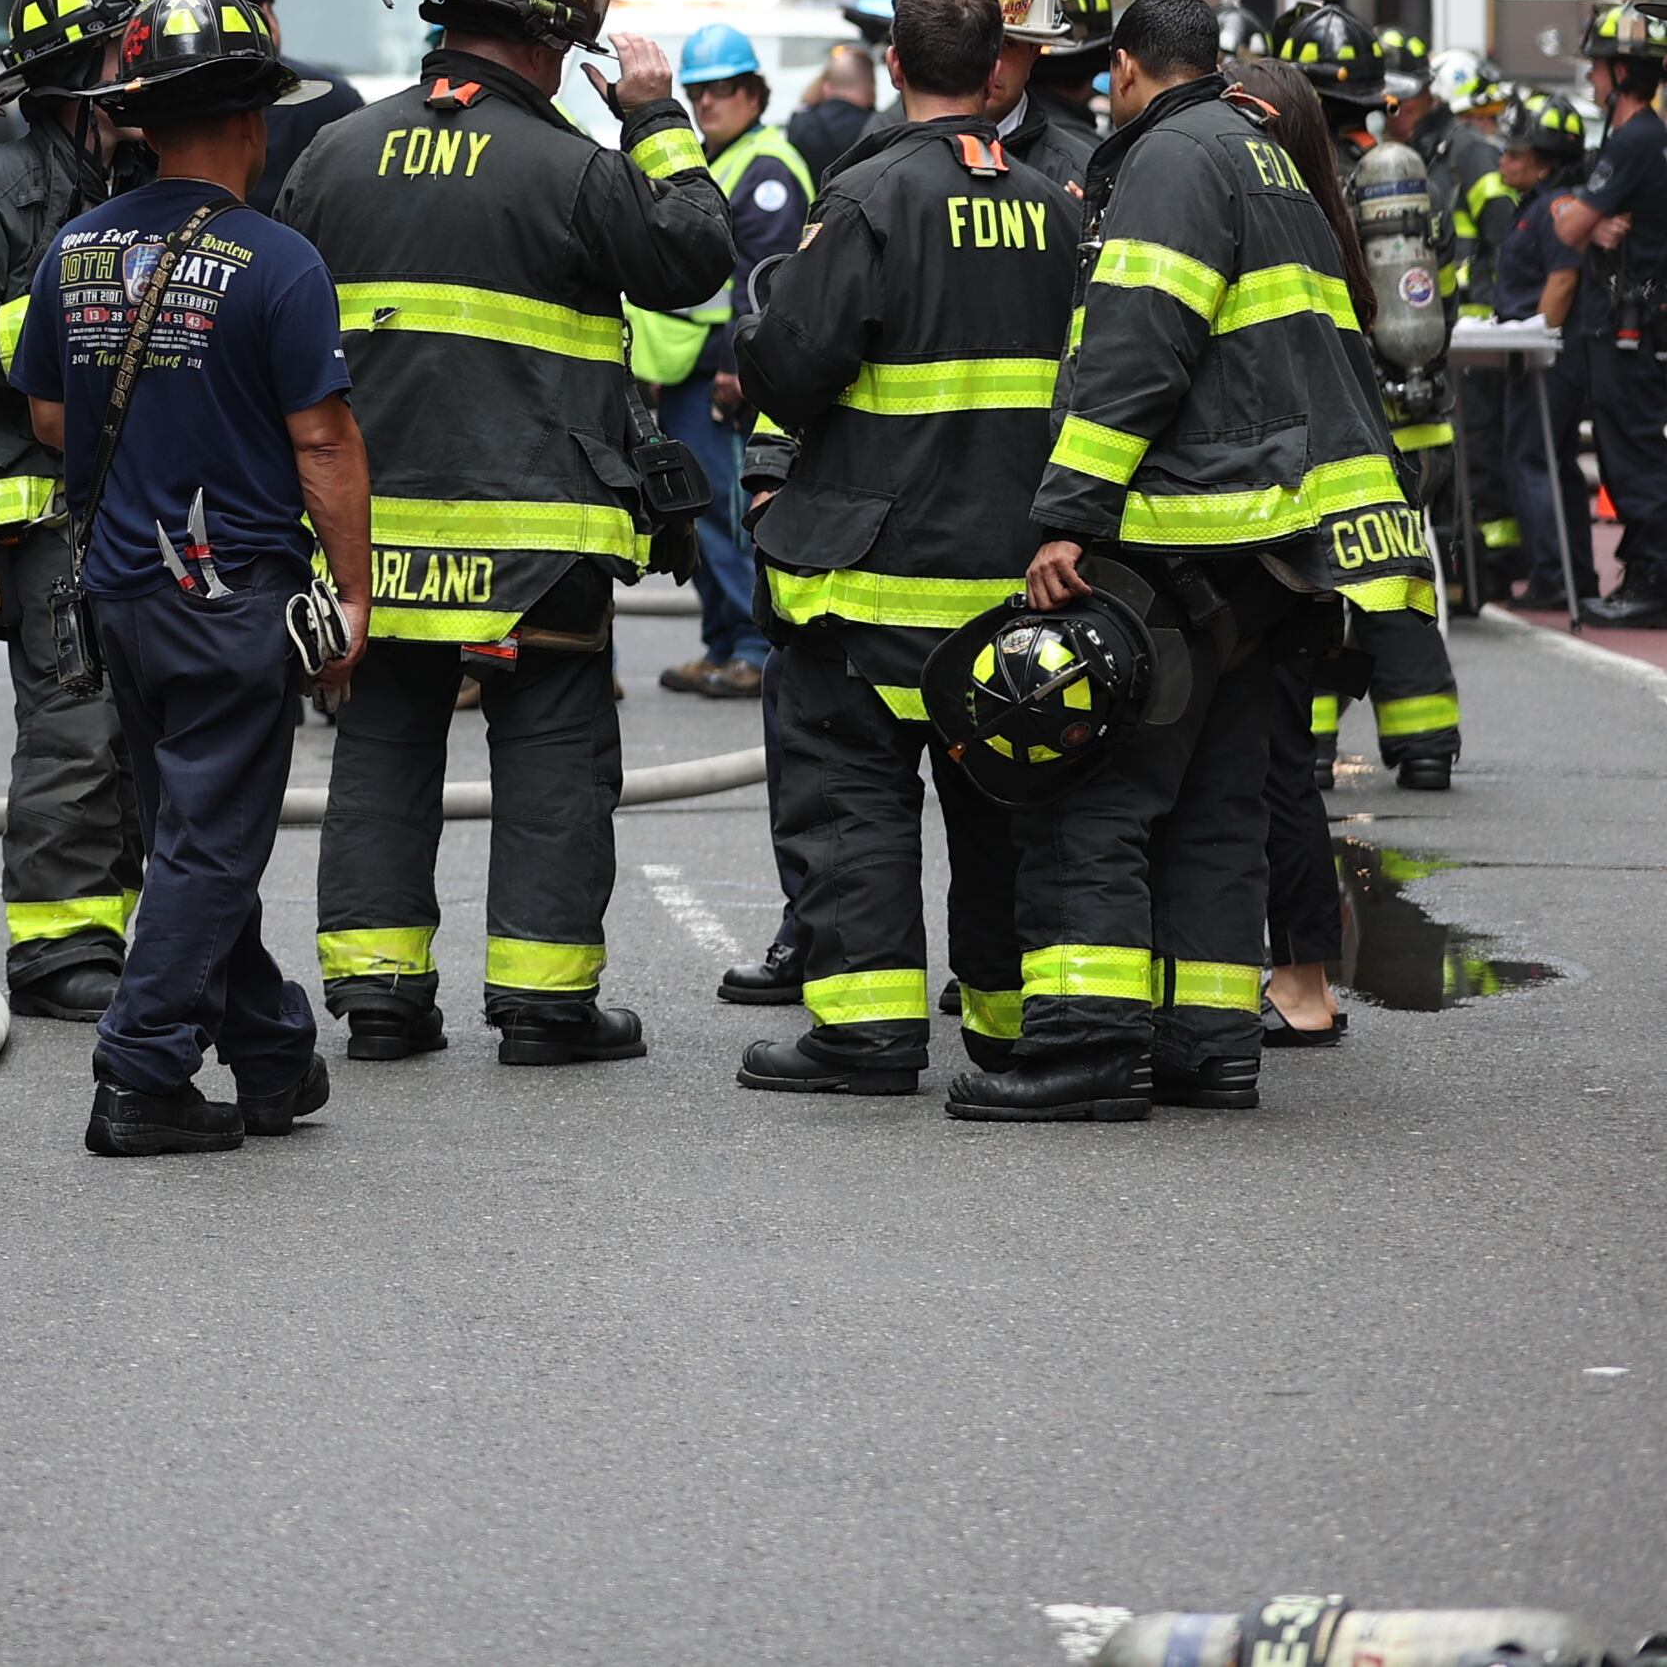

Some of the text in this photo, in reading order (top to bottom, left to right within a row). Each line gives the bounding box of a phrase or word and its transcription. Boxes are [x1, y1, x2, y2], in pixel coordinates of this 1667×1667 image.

[378, 127, 491, 176] FDNY
[948, 197, 1046, 251] FDNY
[99, 228, 139, 246] East
[198, 233, 253, 263] Harlem
[59, 251, 237, 292] 10TH BATT
[89, 310, 100, 321] 13
[111, 311, 123, 322] 39
[173, 313, 184, 324] 53
[188, 315, 201, 327] 43
